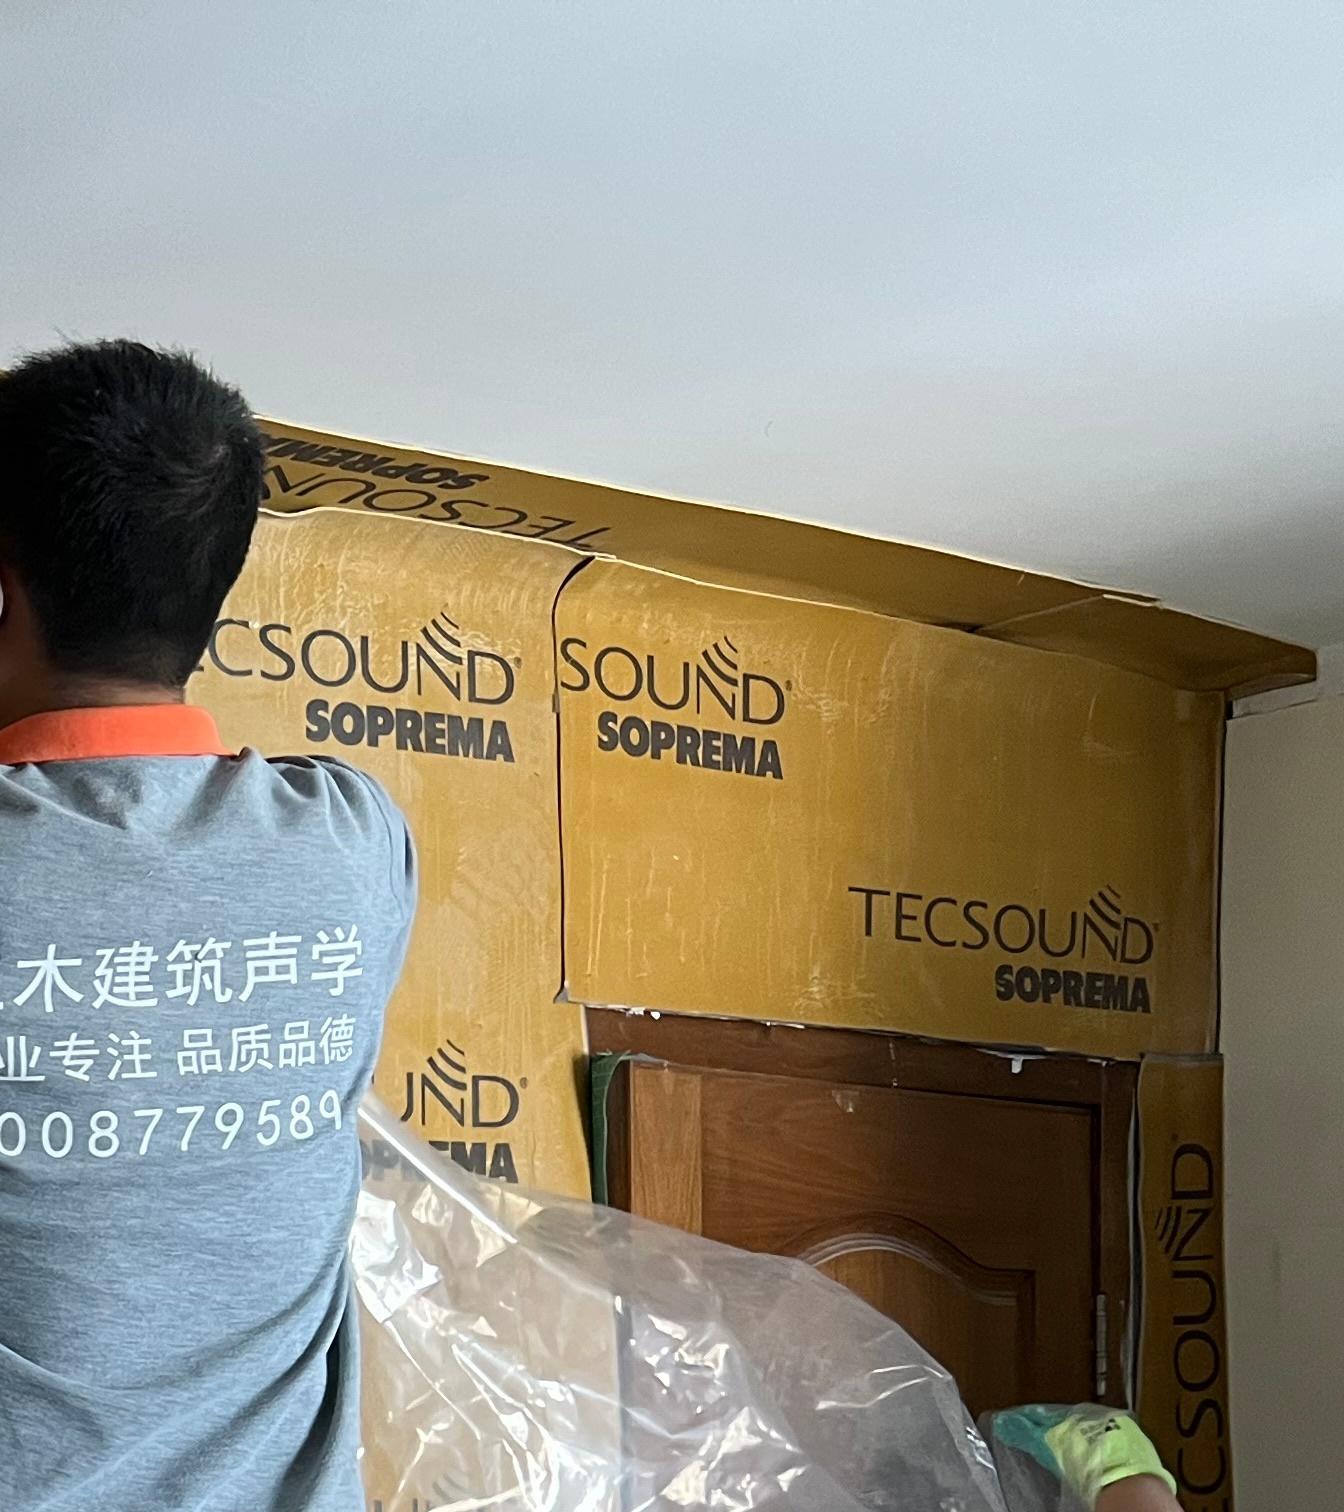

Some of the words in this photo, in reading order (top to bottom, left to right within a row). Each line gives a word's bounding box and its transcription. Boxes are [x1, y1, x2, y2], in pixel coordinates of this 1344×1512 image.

[260, 433, 490, 491] SOPREM
[258, 464, 611, 548] TECSOUN
[194, 618, 515, 705] CSOUND
[305, 699, 515, 763] SOPREMA
[597, 711, 784, 780] SOPREMA
[848, 886, 1154, 965] TECSOUND
[995, 964, 1152, 1014] SOPREMA
[176, 1013, 357, 1076] 品质品德
